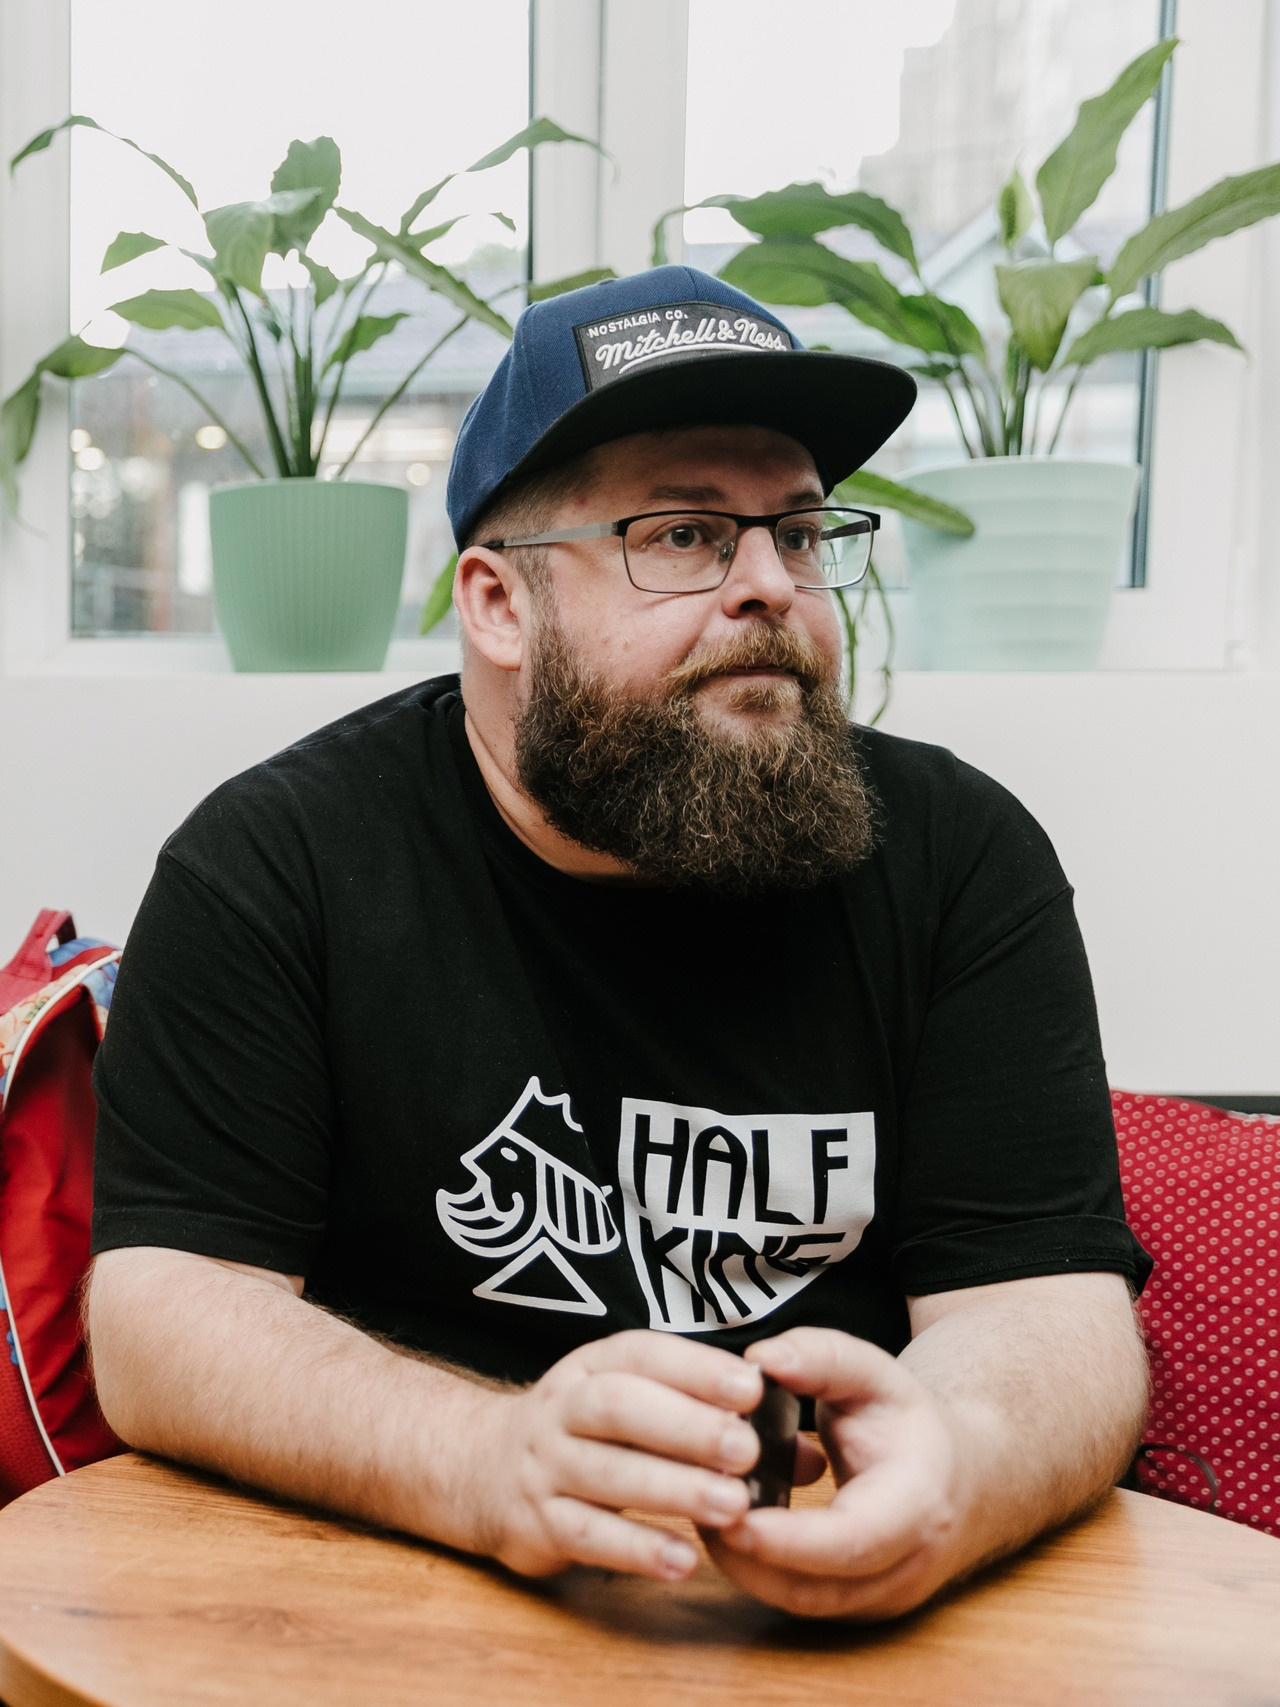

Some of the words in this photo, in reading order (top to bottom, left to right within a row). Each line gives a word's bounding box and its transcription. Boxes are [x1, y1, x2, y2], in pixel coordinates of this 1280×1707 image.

[588, 312, 661, 339] NOSTALGIA
[664, 309, 689, 321] CO.
[632, 1113, 849, 1225] HALF
[638, 1214, 847, 1325] KING
